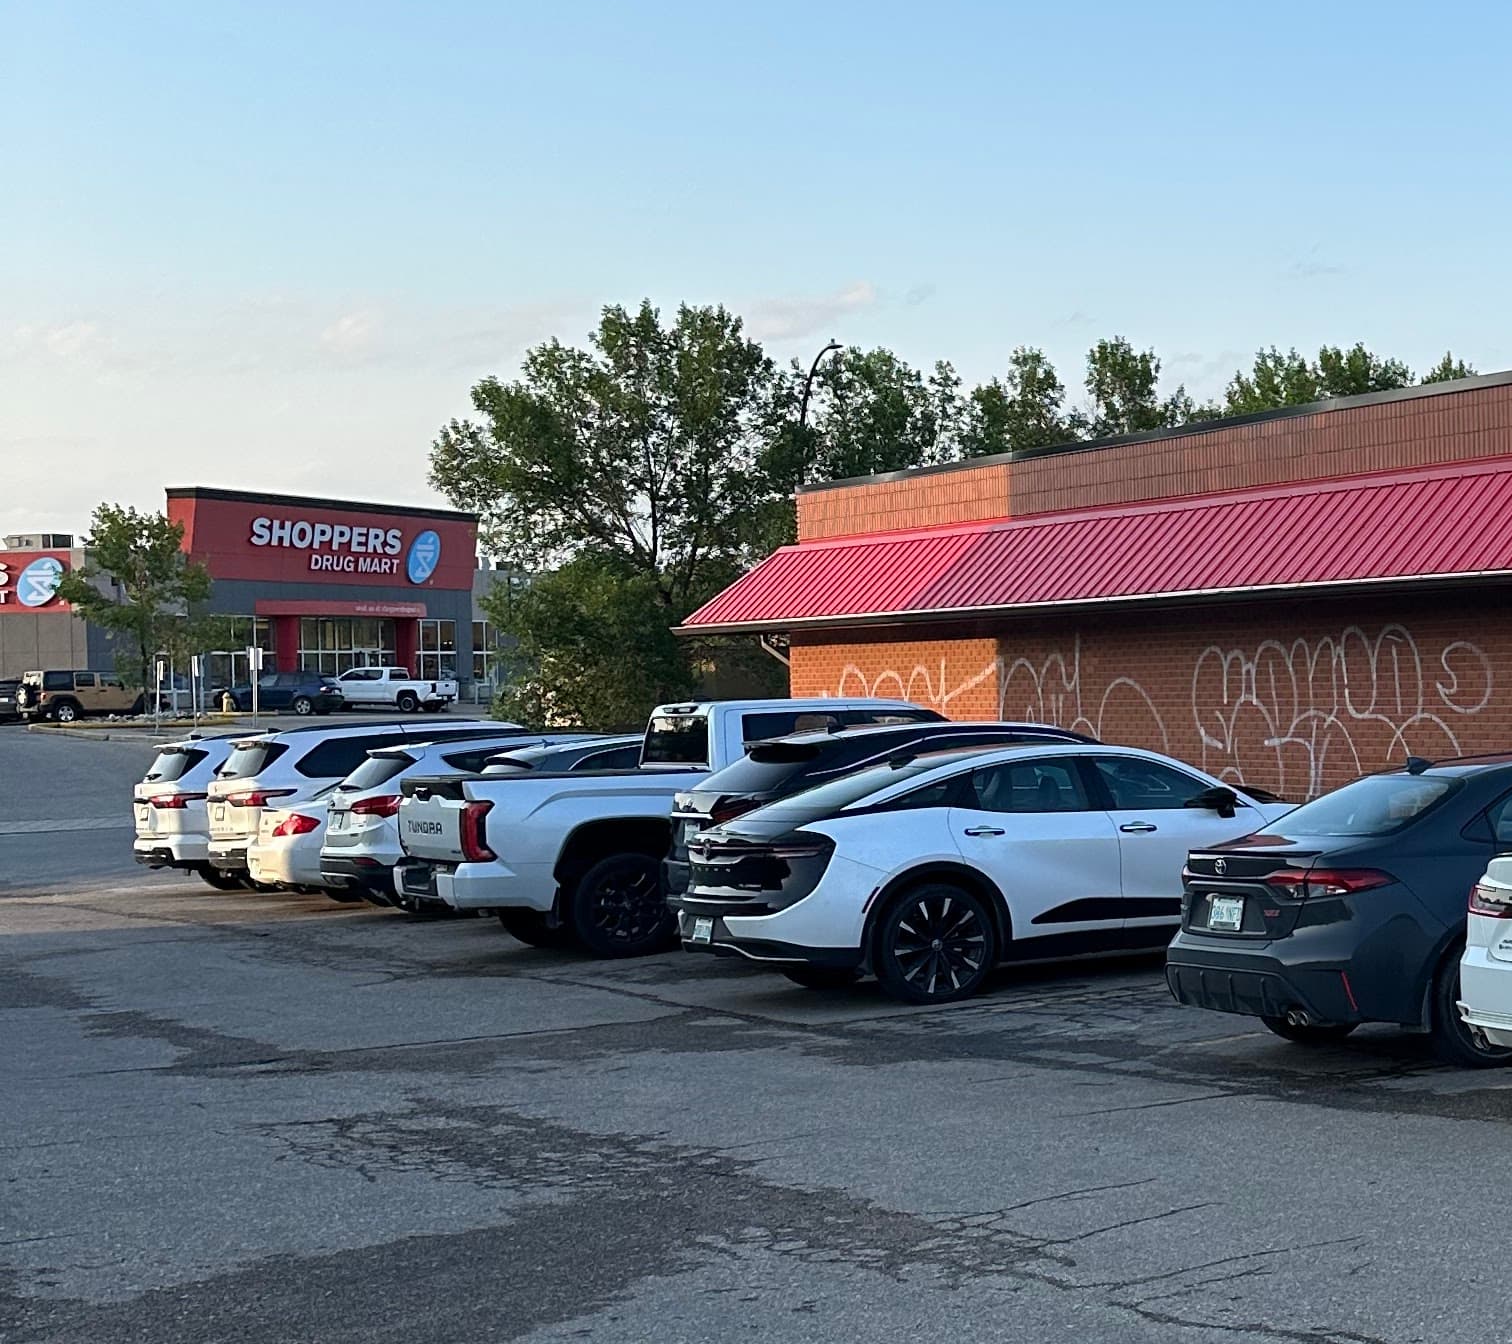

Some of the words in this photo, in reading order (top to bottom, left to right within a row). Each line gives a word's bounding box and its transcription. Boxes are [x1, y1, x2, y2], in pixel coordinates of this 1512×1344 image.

[250, 517, 402, 555] SHOPPERS
[310, 554, 354, 572] DRUG
[358, 557, 400, 574] MART
[407, 820, 443, 835] TUNDRA
